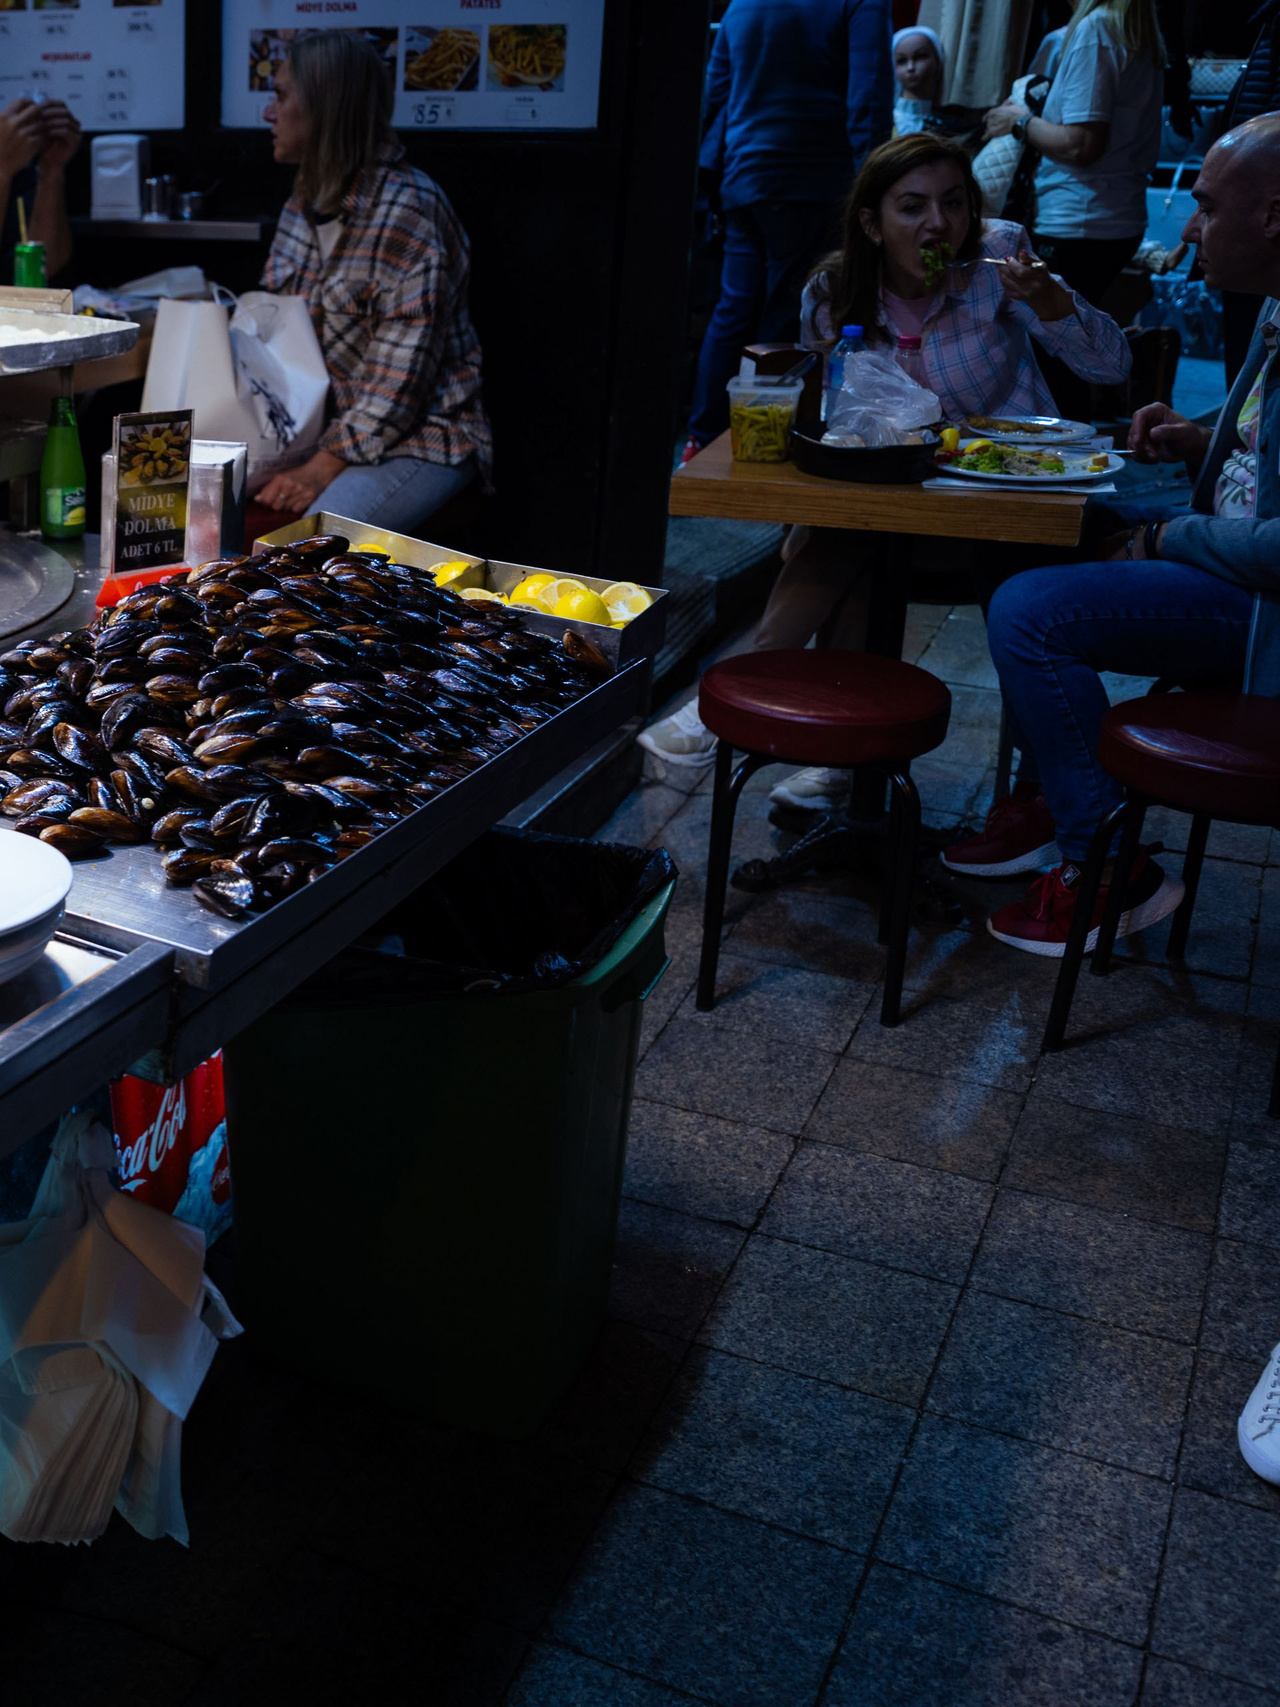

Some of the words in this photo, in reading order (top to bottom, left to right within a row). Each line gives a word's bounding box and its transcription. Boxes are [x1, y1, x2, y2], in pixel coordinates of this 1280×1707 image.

[128, 492, 176, 512] MİDYE
[124, 516, 177, 536] DOLMA
[120, 543, 153, 559] ADET
[154, 541, 161, 554] 6
[163, 540, 178, 553] TL
